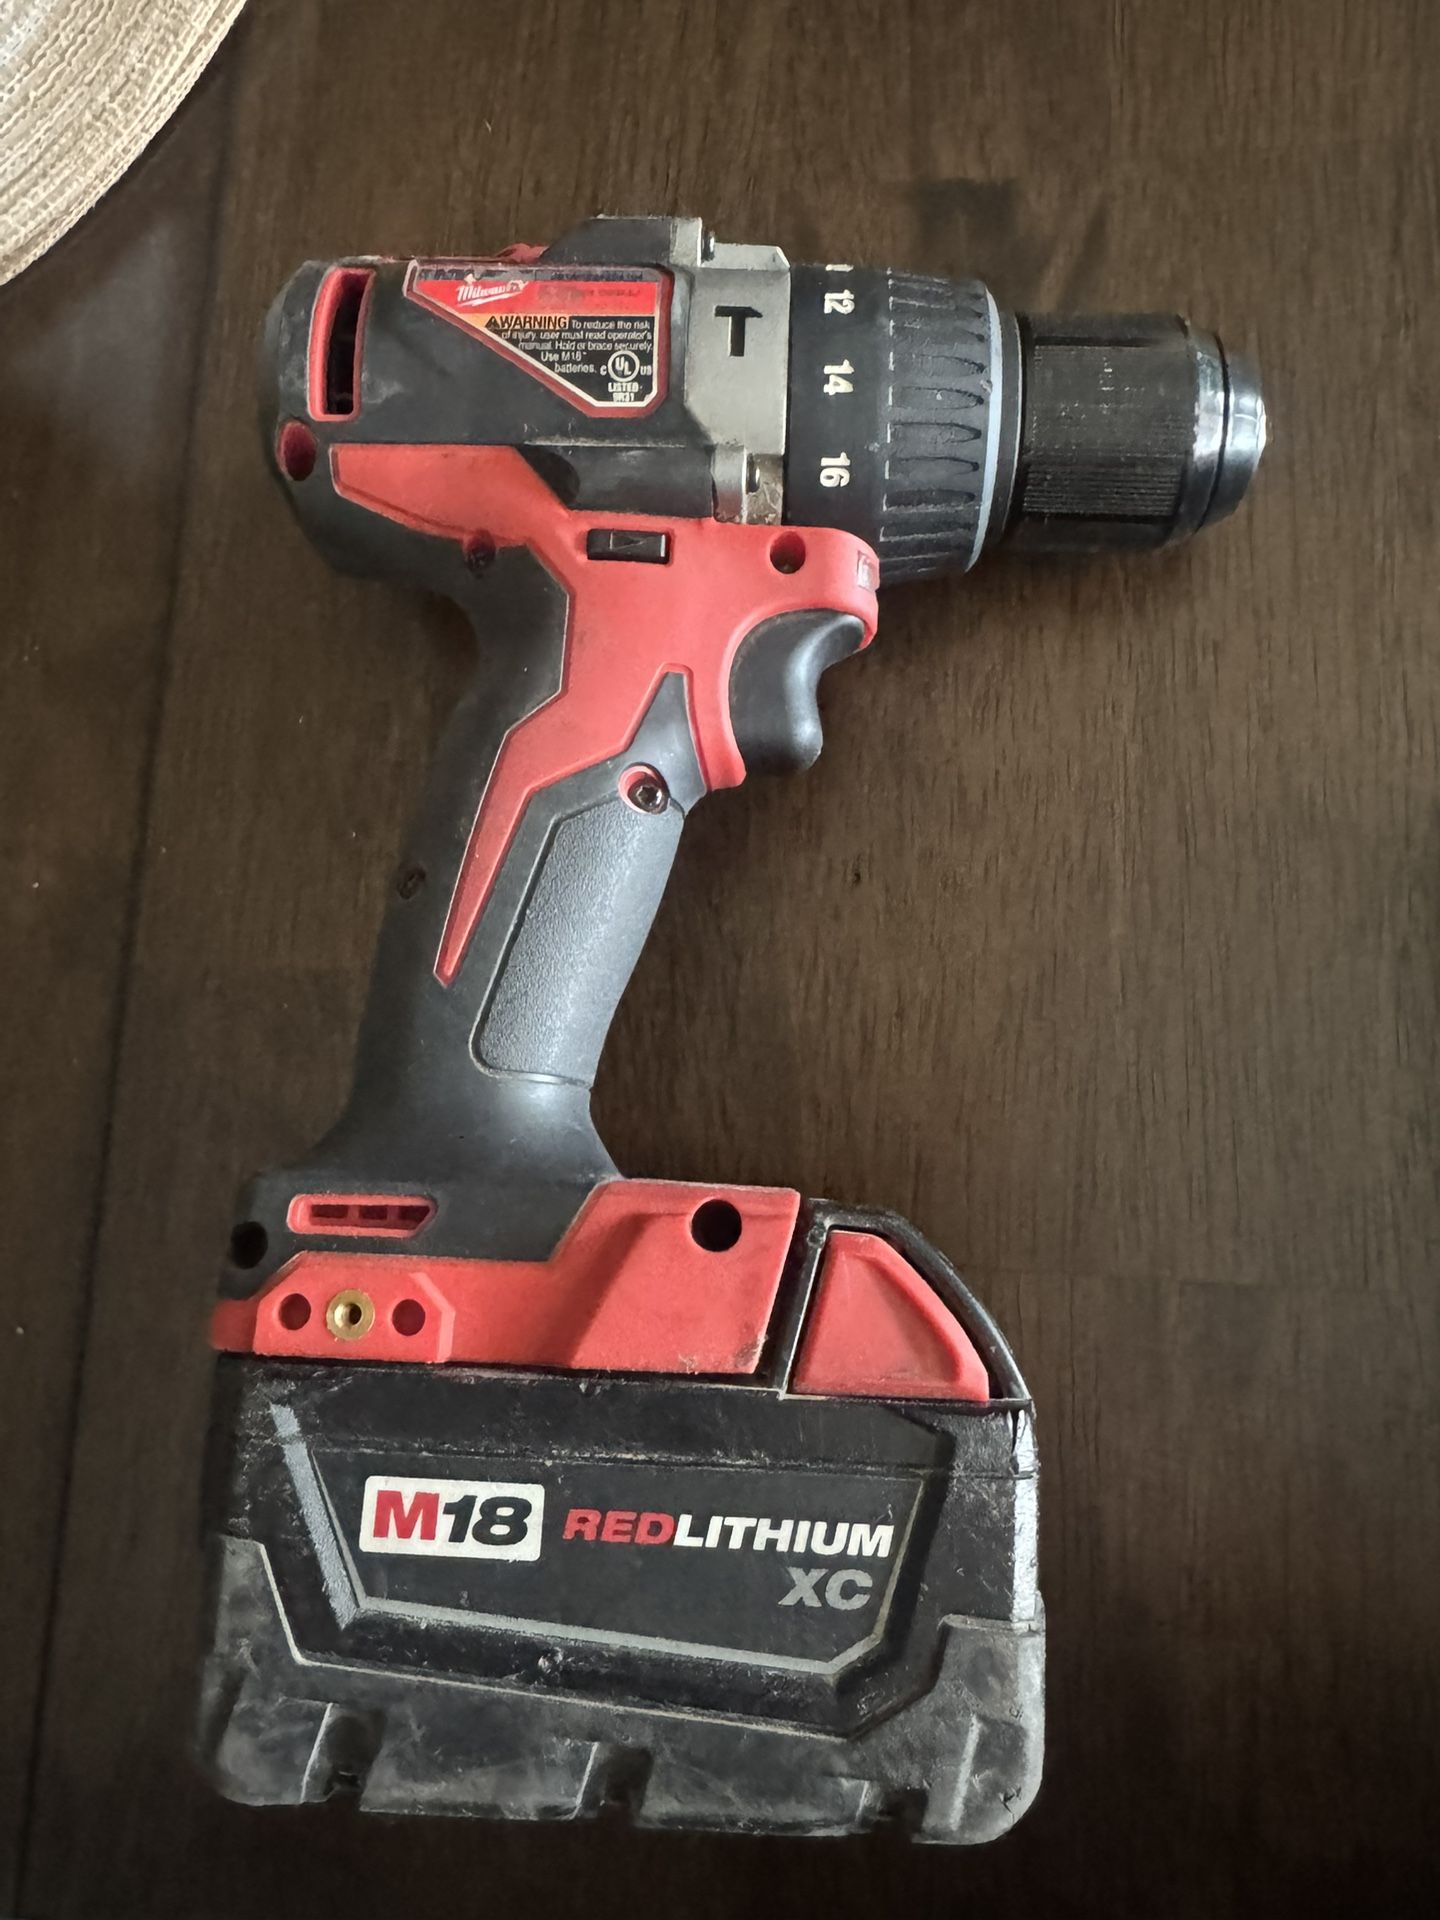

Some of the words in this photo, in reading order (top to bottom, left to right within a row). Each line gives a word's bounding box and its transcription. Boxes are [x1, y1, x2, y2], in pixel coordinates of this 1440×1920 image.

[824, 288, 856, 316] 12
[499, 315, 567, 330] WARNING
[571, 319, 582, 330] To
[583, 319, 615, 330] reduce
[617, 320, 632, 330] the
[634, 320, 651, 330] risk
[540, 331, 560, 340] user
[561, 331, 584, 340] must
[585, 331, 606, 340] read
[607, 330, 652, 342] operator's
[555, 340, 576, 351] Hold
[576, 342, 587, 351] or
[587, 341, 613, 351] brace
[540, 351, 560, 362] Use
[554, 362, 597, 374] batteries.
[823, 358, 855, 396] 14
[607, 382, 639, 393] LISTED
[819, 451, 851, 488] 16
[372, 1488, 533, 1547] M18
[562, 1508, 895, 1558] REDLITHIUM
[778, 1567, 874, 1611] XC
